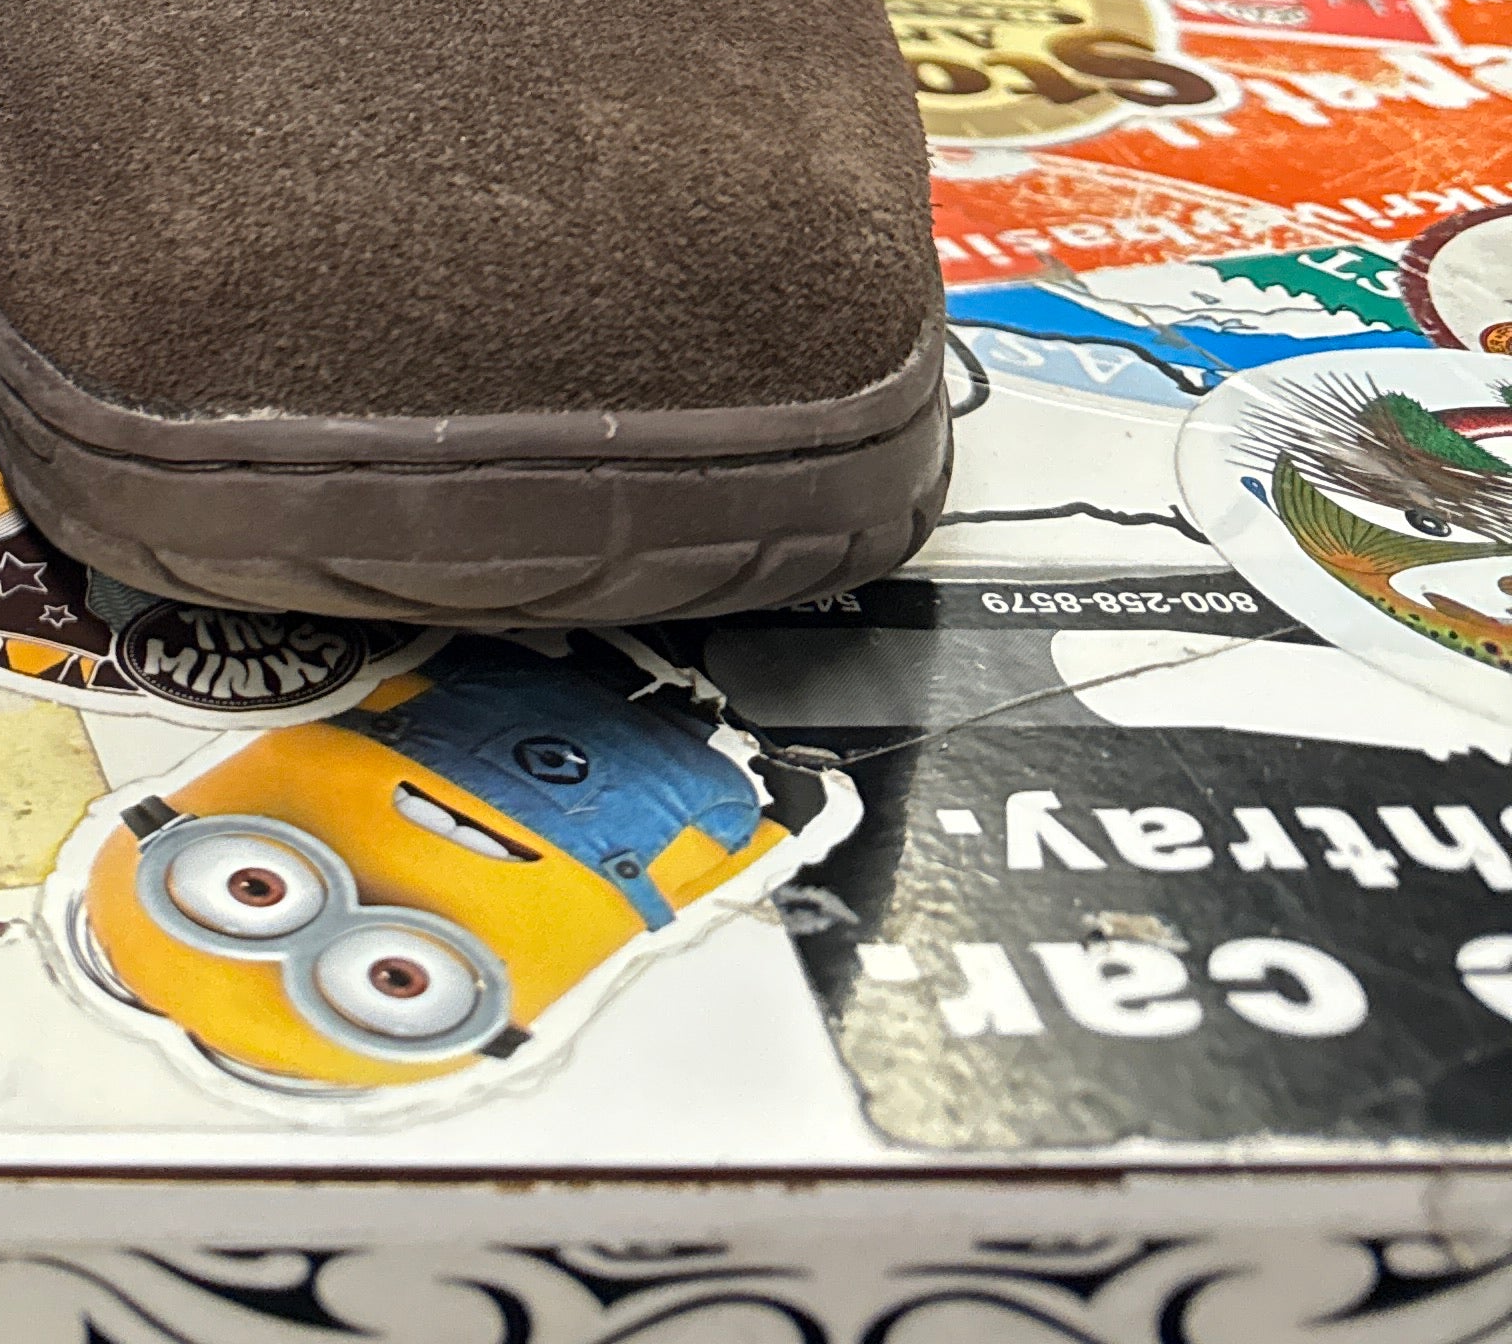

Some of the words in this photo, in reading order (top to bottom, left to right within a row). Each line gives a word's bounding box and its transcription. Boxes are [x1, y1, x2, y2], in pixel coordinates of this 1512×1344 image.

[912, 34, 1217, 106] Sto
[981, 591, 1259, 614] 800-258-8579
[144, 623, 347, 699] MINKS
[937, 789, 1512, 892] htray.
[861, 936, 1371, 1040] car.
